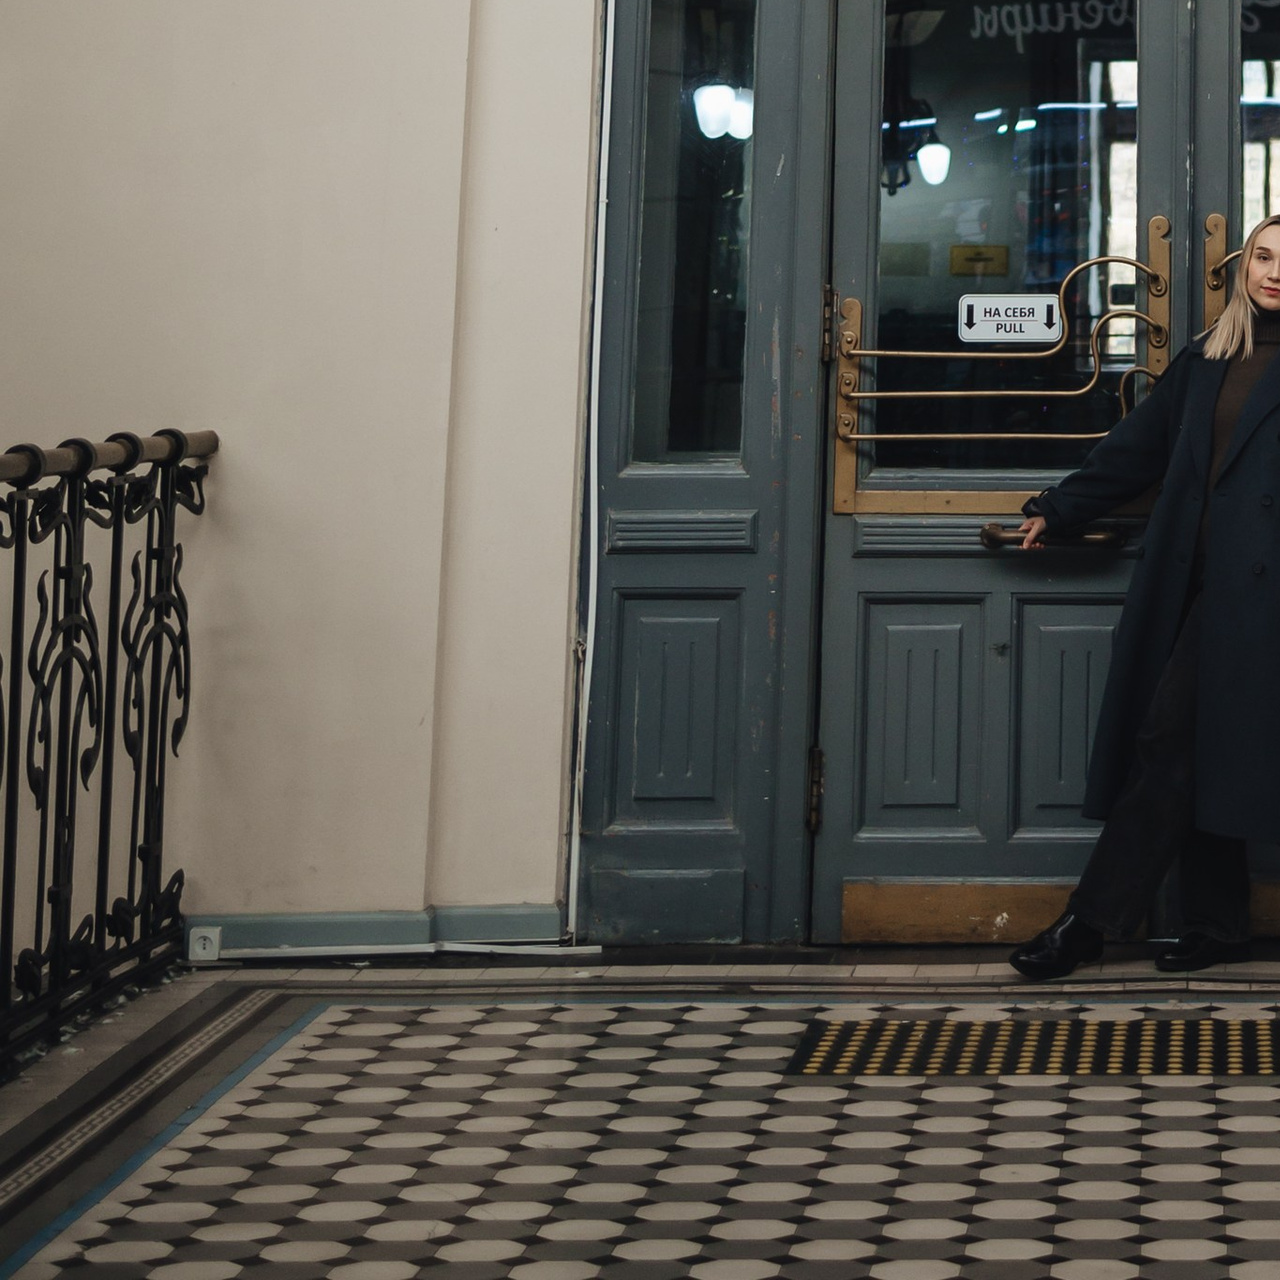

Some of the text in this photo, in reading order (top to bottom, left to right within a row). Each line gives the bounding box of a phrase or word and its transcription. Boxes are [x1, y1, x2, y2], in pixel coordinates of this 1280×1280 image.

[983, 307, 1036, 318] НА СЕБЯ
[995, 322, 1026, 334] PULL
